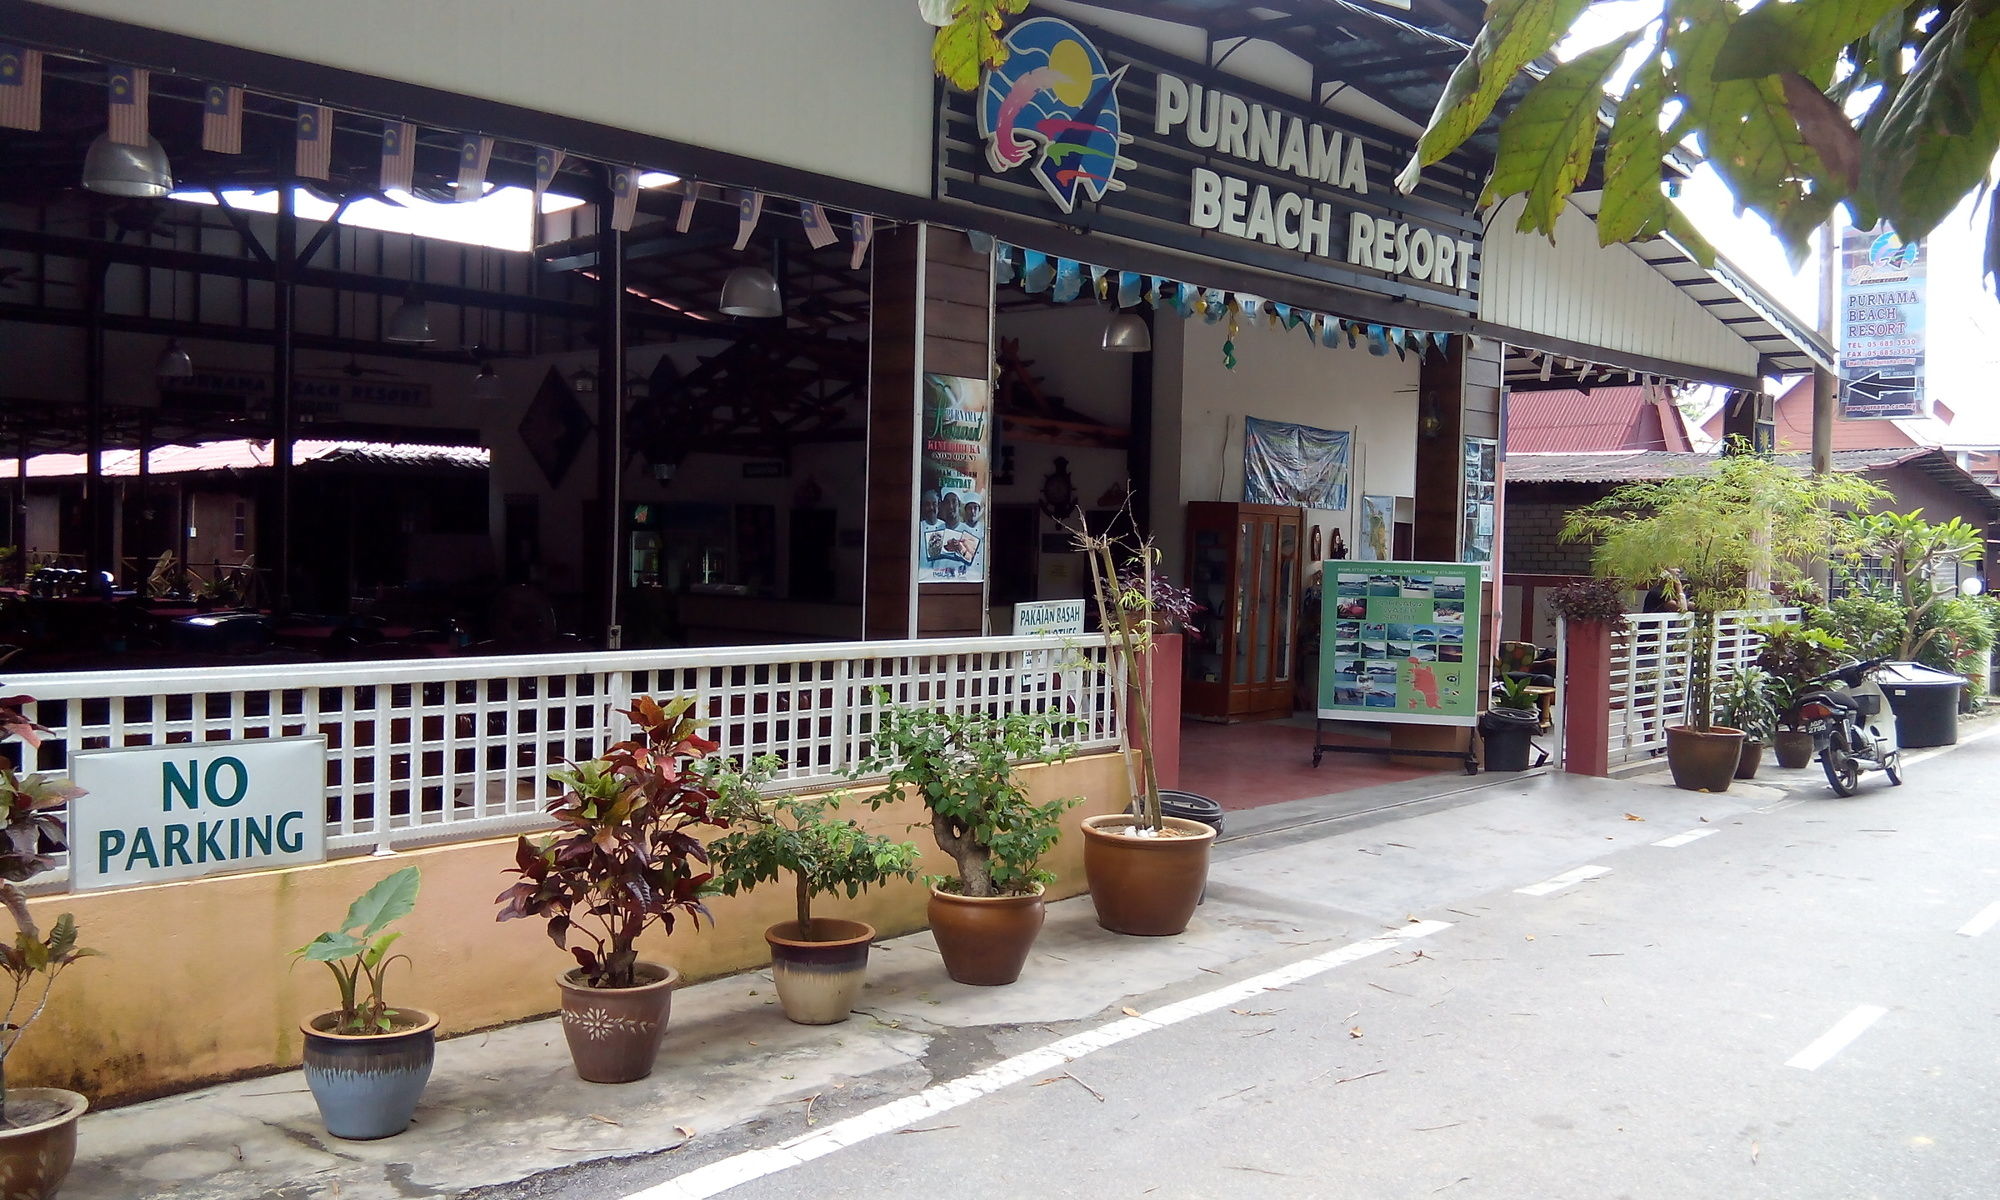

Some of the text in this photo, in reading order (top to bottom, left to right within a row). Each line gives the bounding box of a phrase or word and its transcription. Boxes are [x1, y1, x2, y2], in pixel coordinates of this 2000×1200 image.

[1154, 73, 1368, 194] PURNAMA
[1190, 168, 1473, 290] BEACH RESORT
[1849, 292, 1917, 306] PURNAMA
[1849, 308, 1896, 321] BEACH
[1849, 323, 1905, 336] RESORT
[1020, 606, 1080, 626] PAKAIAN BASAH
[162, 756, 249, 812] NO
[99, 811, 303, 874] PARKING
